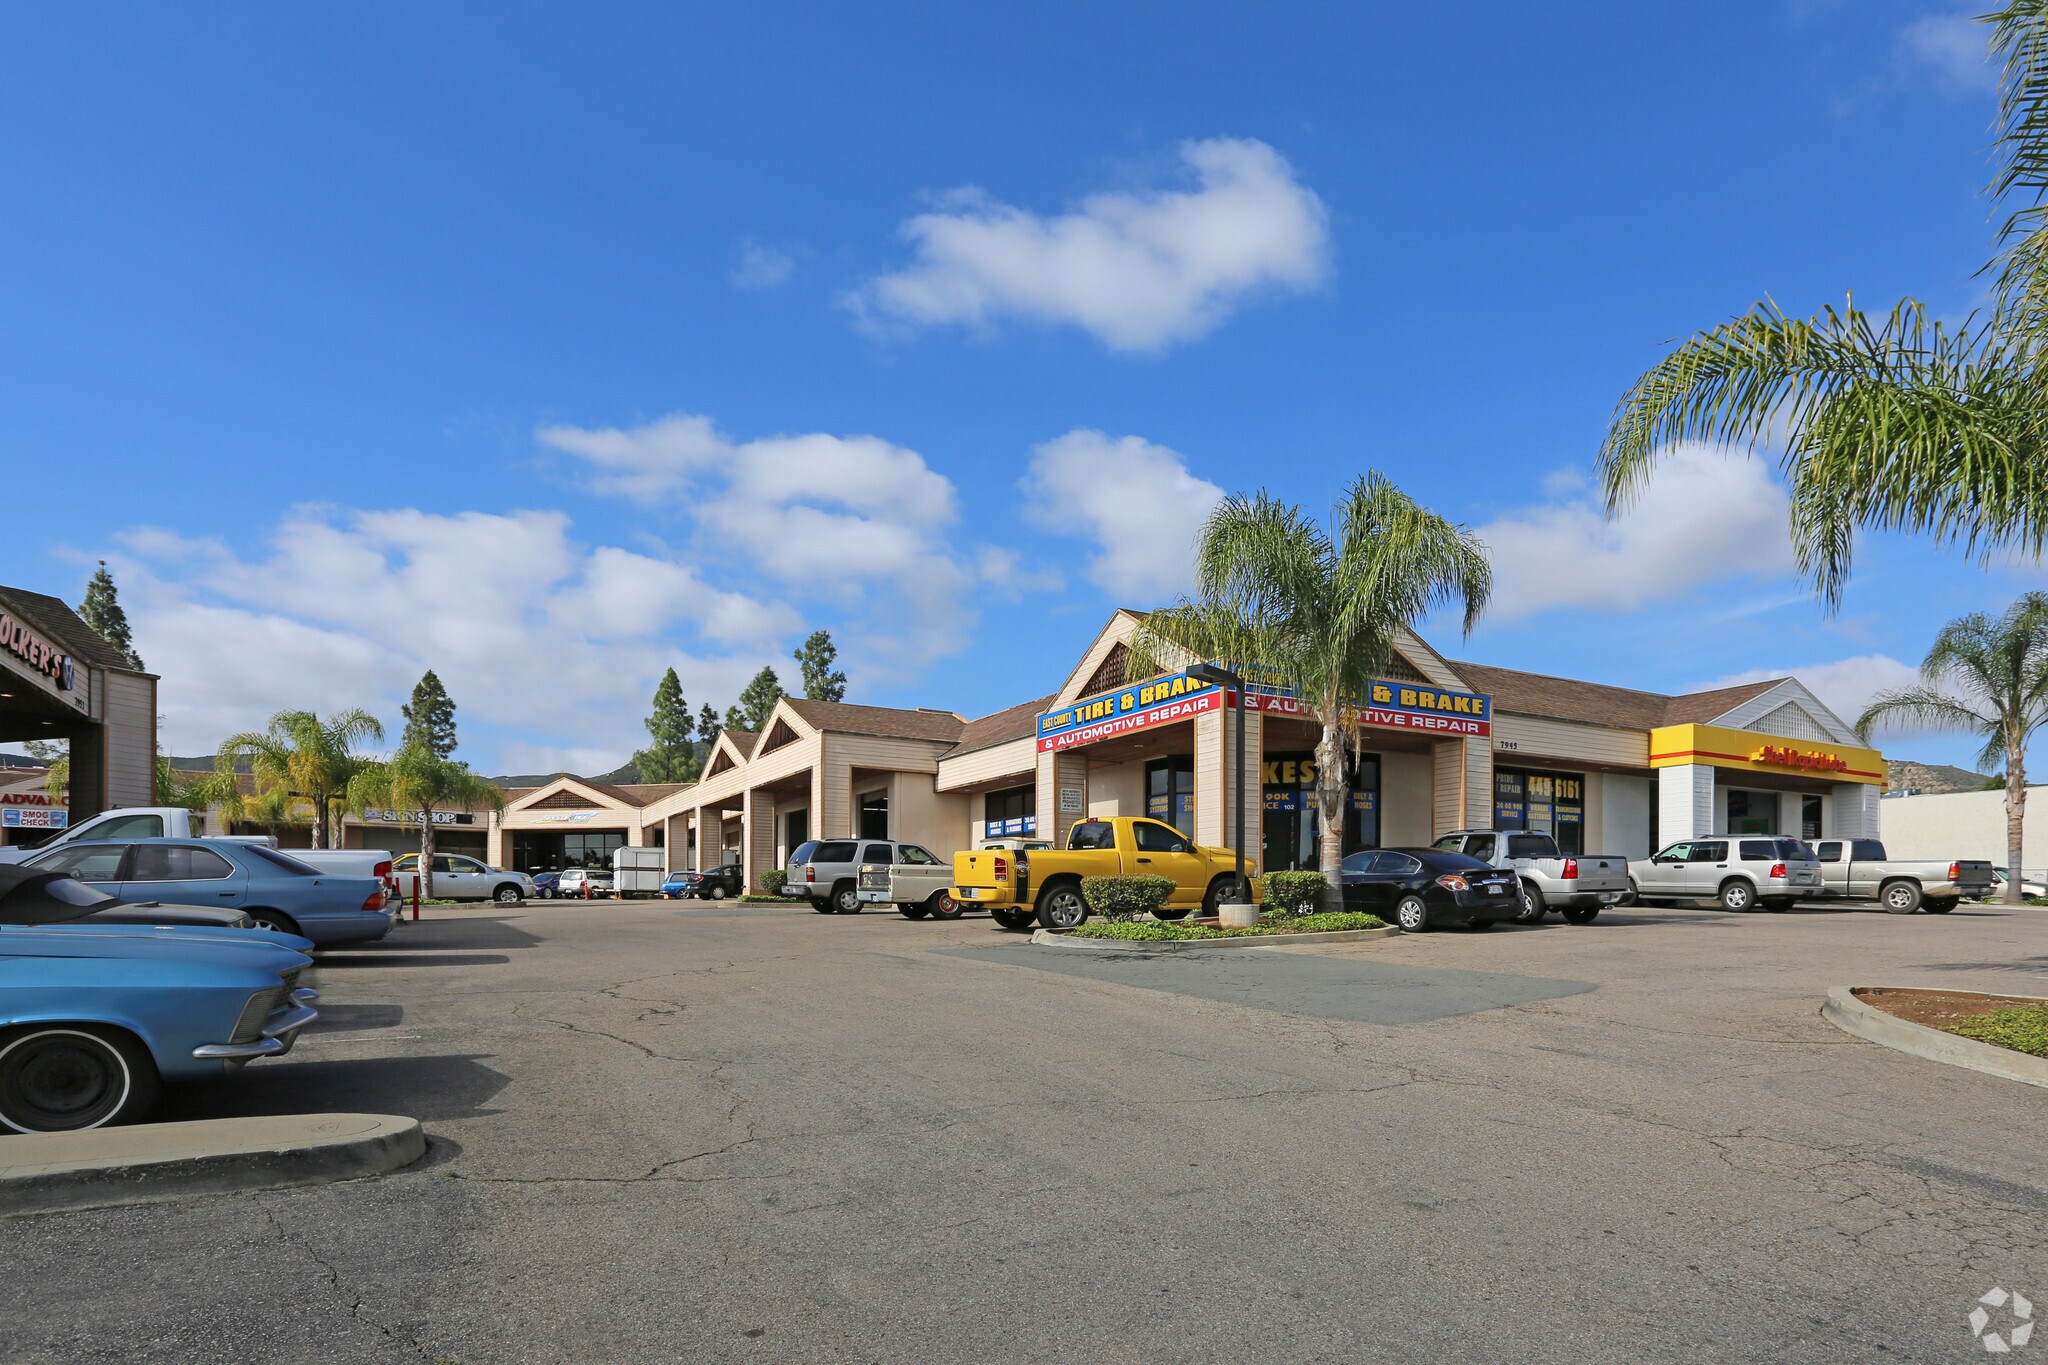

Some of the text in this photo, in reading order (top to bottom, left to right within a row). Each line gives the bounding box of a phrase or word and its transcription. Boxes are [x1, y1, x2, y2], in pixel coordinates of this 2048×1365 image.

[1043, 717, 1053, 730] EAST
[1054, 711, 1071, 726] COUNTY
[1075, 698, 1114, 723] TIRE
[1120, 692, 1134, 710] &
[1245, 696, 1259, 707] &
[1412, 716, 1479, 733] REPAIR
[1372, 685, 1392, 703] &
[1400, 688, 1484, 715] BRAKE
[1045, 698, 1209, 748] & AUTOMOTIVE REPAIR
[1501, 741, 1517, 749] 7945
